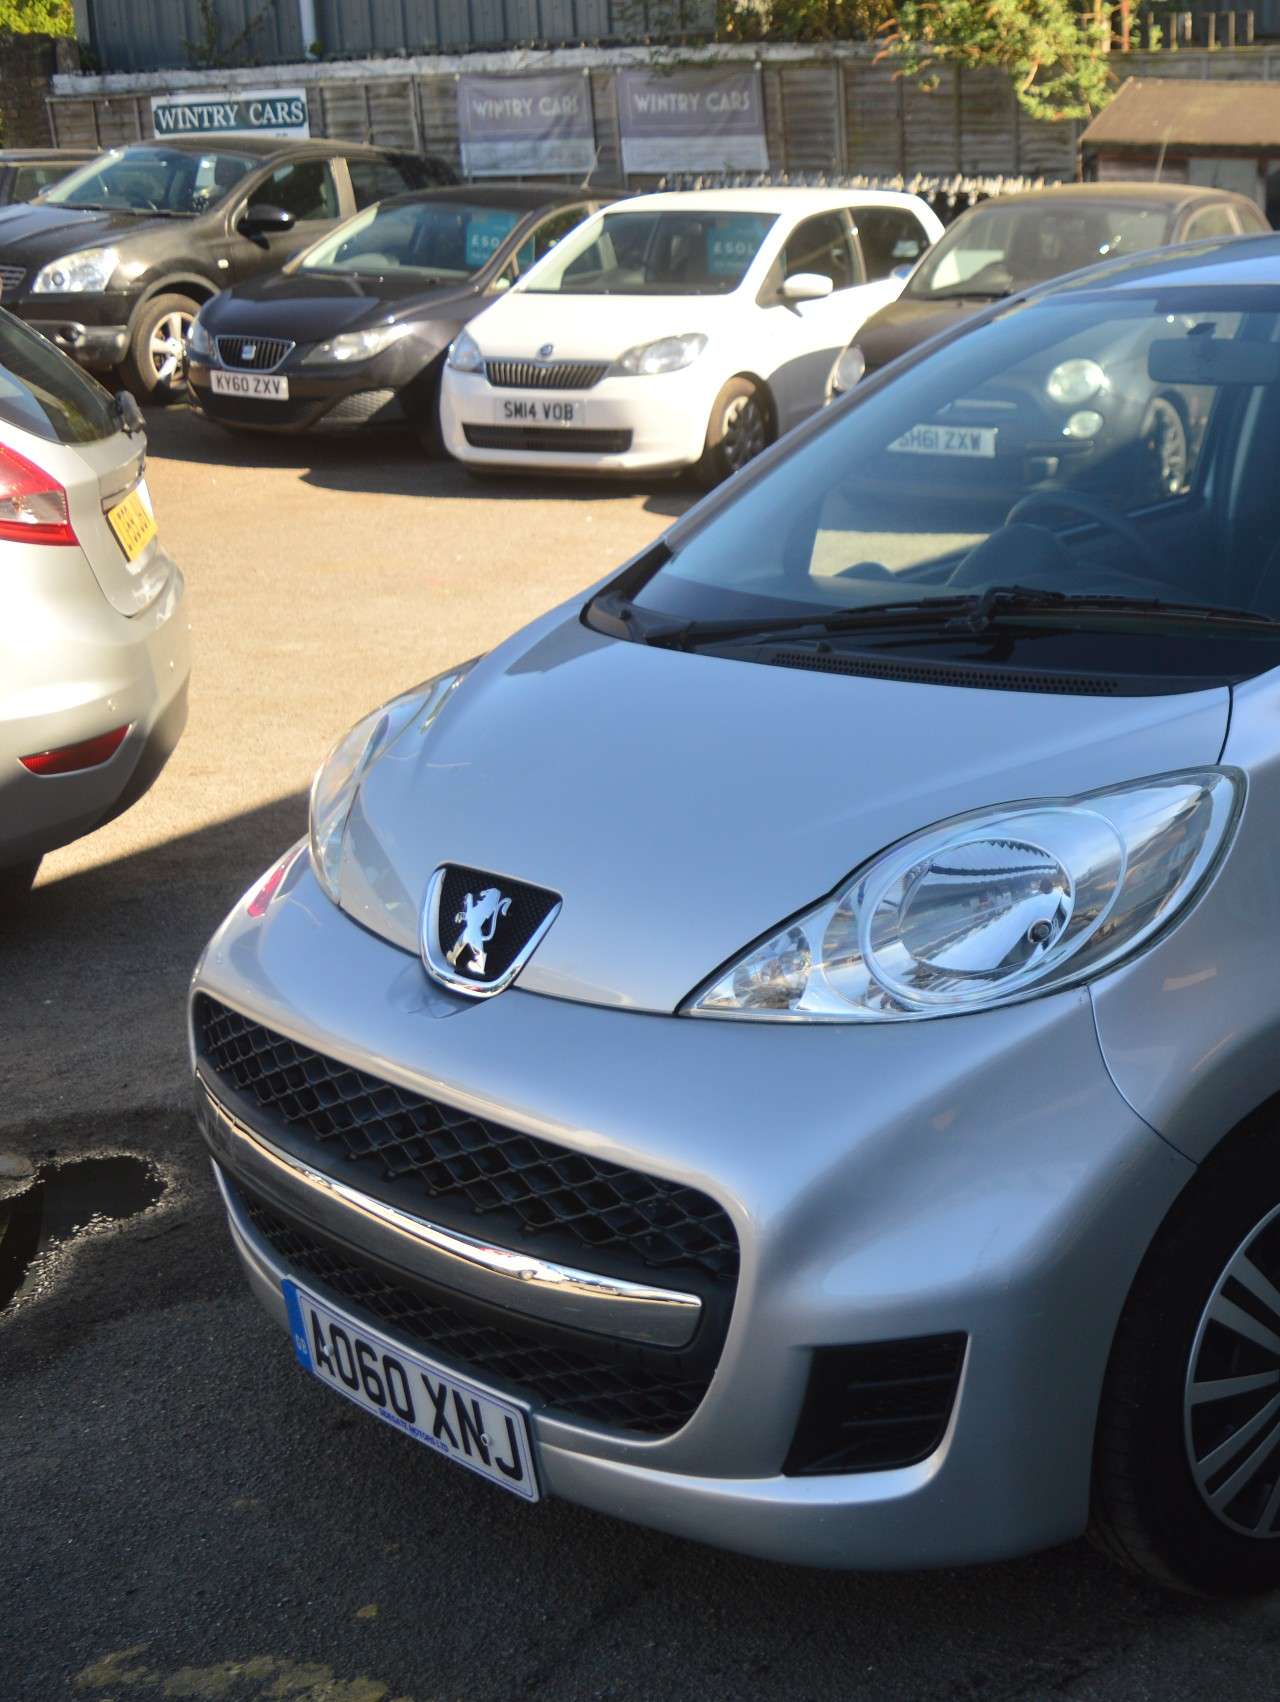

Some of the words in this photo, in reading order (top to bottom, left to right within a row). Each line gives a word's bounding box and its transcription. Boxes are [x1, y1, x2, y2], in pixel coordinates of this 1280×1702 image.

[473, 97, 533, 118] WINTRY
[539, 96, 578, 117] CARS
[634, 93, 700, 113] WINTRY
[703, 91, 750, 112] CARS
[158, 104, 238, 130] WINTRY
[250, 101, 303, 126] CARS
[216, 375, 249, 392] KY60
[254, 378, 280, 395] ZXV
[504, 401, 537, 419] SM14
[542, 403, 574, 420] VOB
[944, 430, 982, 451] ZXW
[311, 1310, 416, 1424] AO60
[421, 1372, 524, 1481] XNJ
